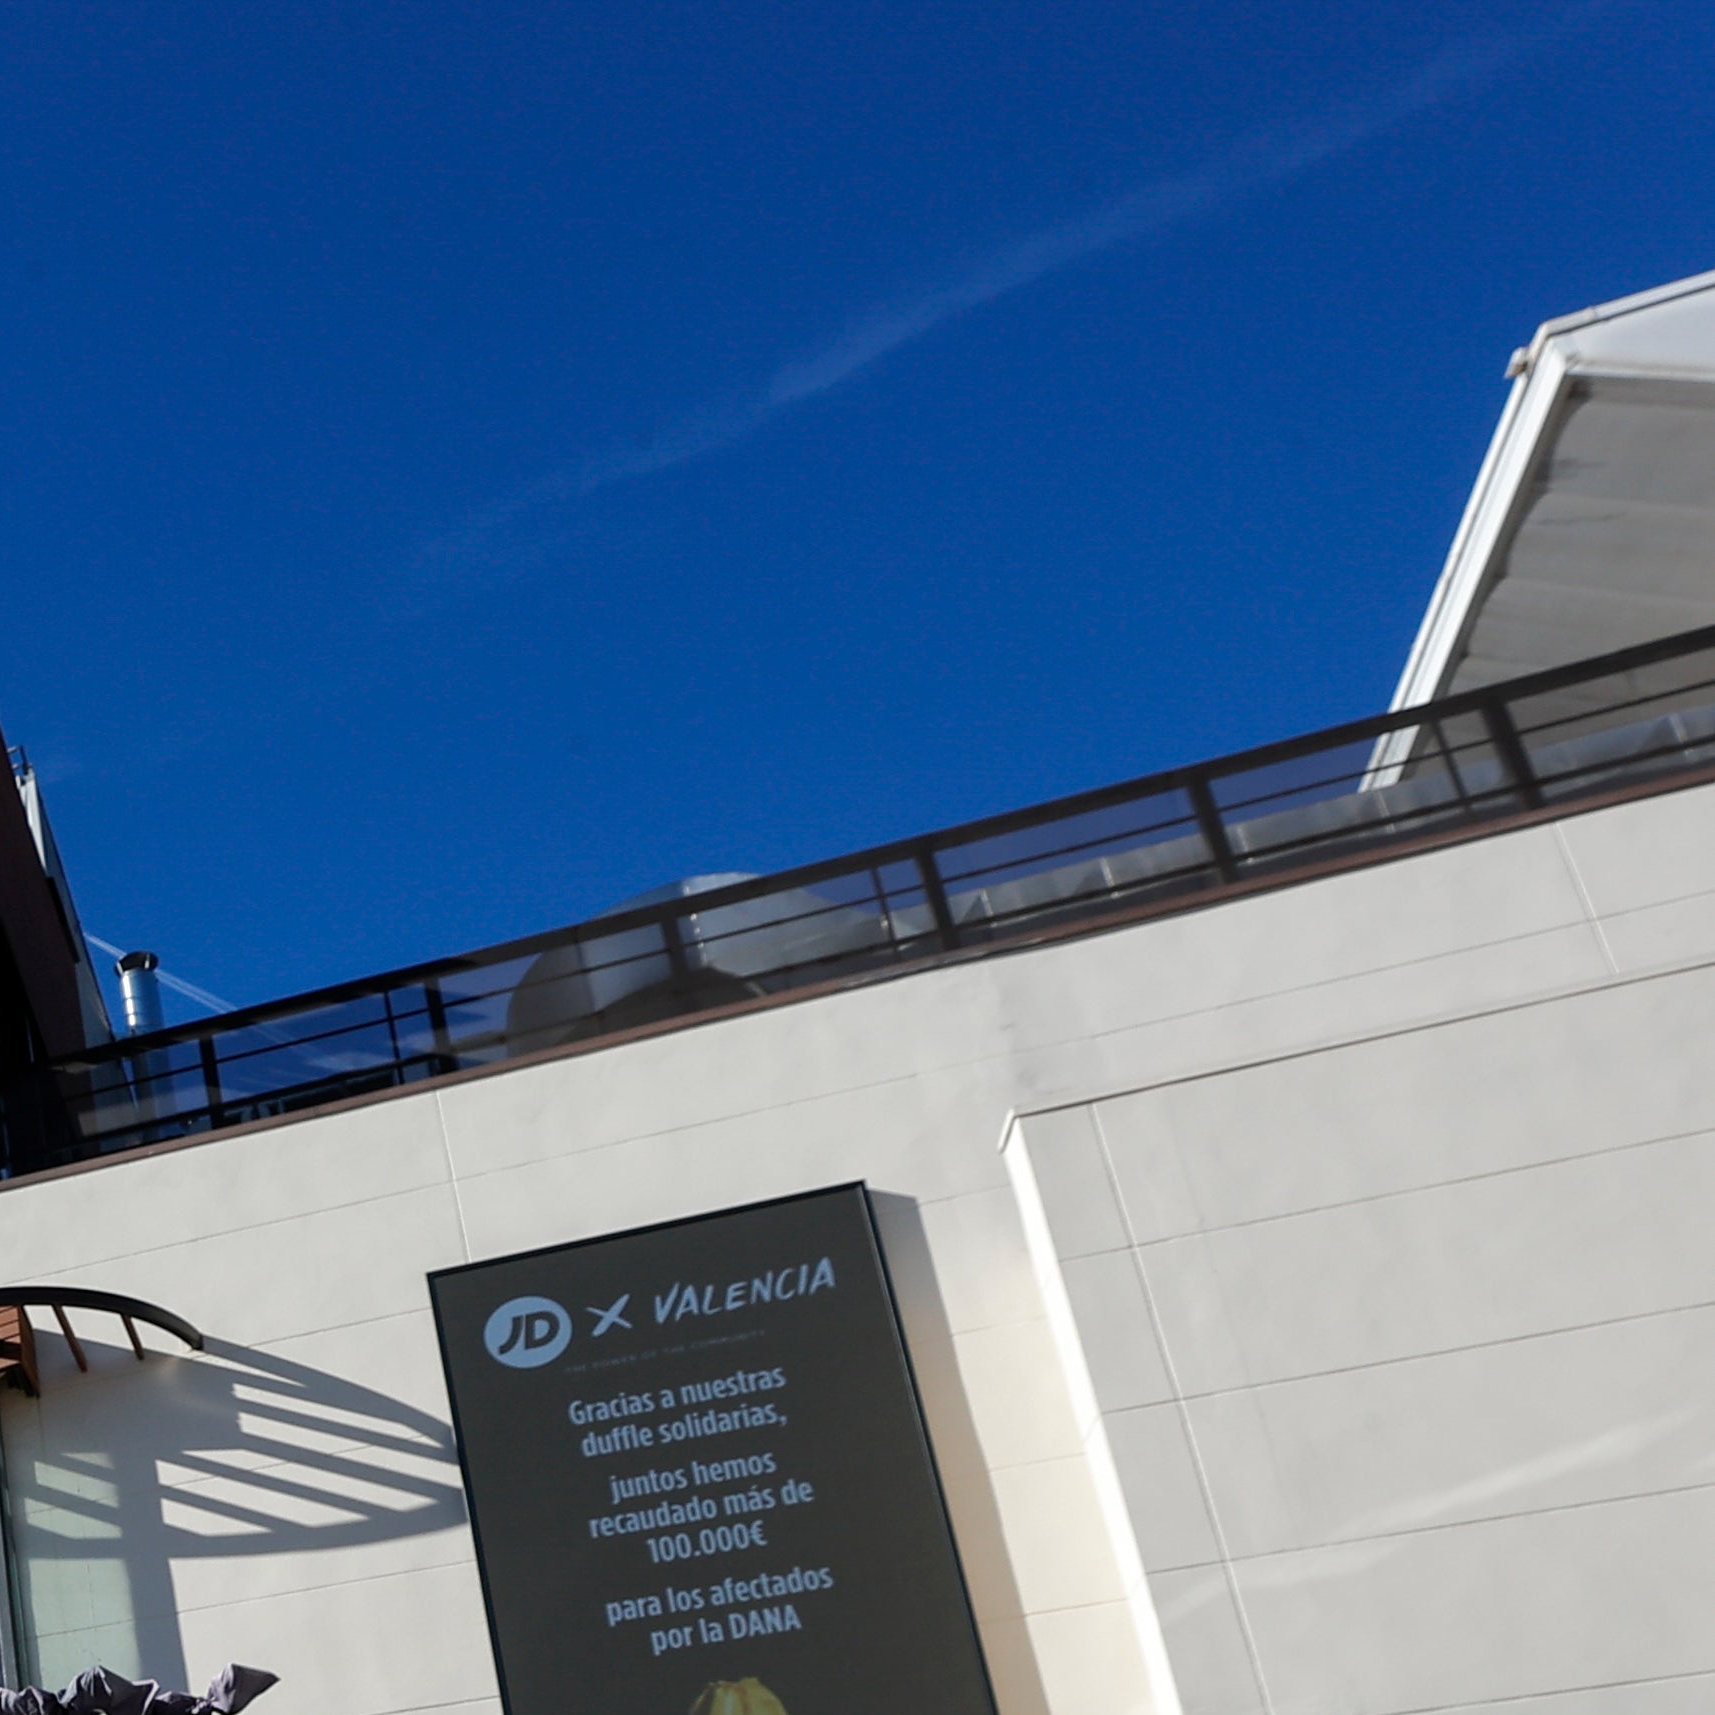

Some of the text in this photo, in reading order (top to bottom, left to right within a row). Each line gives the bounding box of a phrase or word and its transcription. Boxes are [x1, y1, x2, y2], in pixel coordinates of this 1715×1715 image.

[497, 1309, 562, 1357] JD
[654, 1256, 836, 1325] VALENCIA
[568, 1366, 787, 1426] Gracias a nuestras
[580, 1402, 788, 1457] duffle solidarias,
[609, 1452, 777, 1505] juntos hemos
[588, 1478, 815, 1539] recaudado más de
[646, 1519, 768, 1564] 100.000€
[604, 1566, 834, 1627] para los afectados
[650, 1603, 802, 1656] por la DANA
